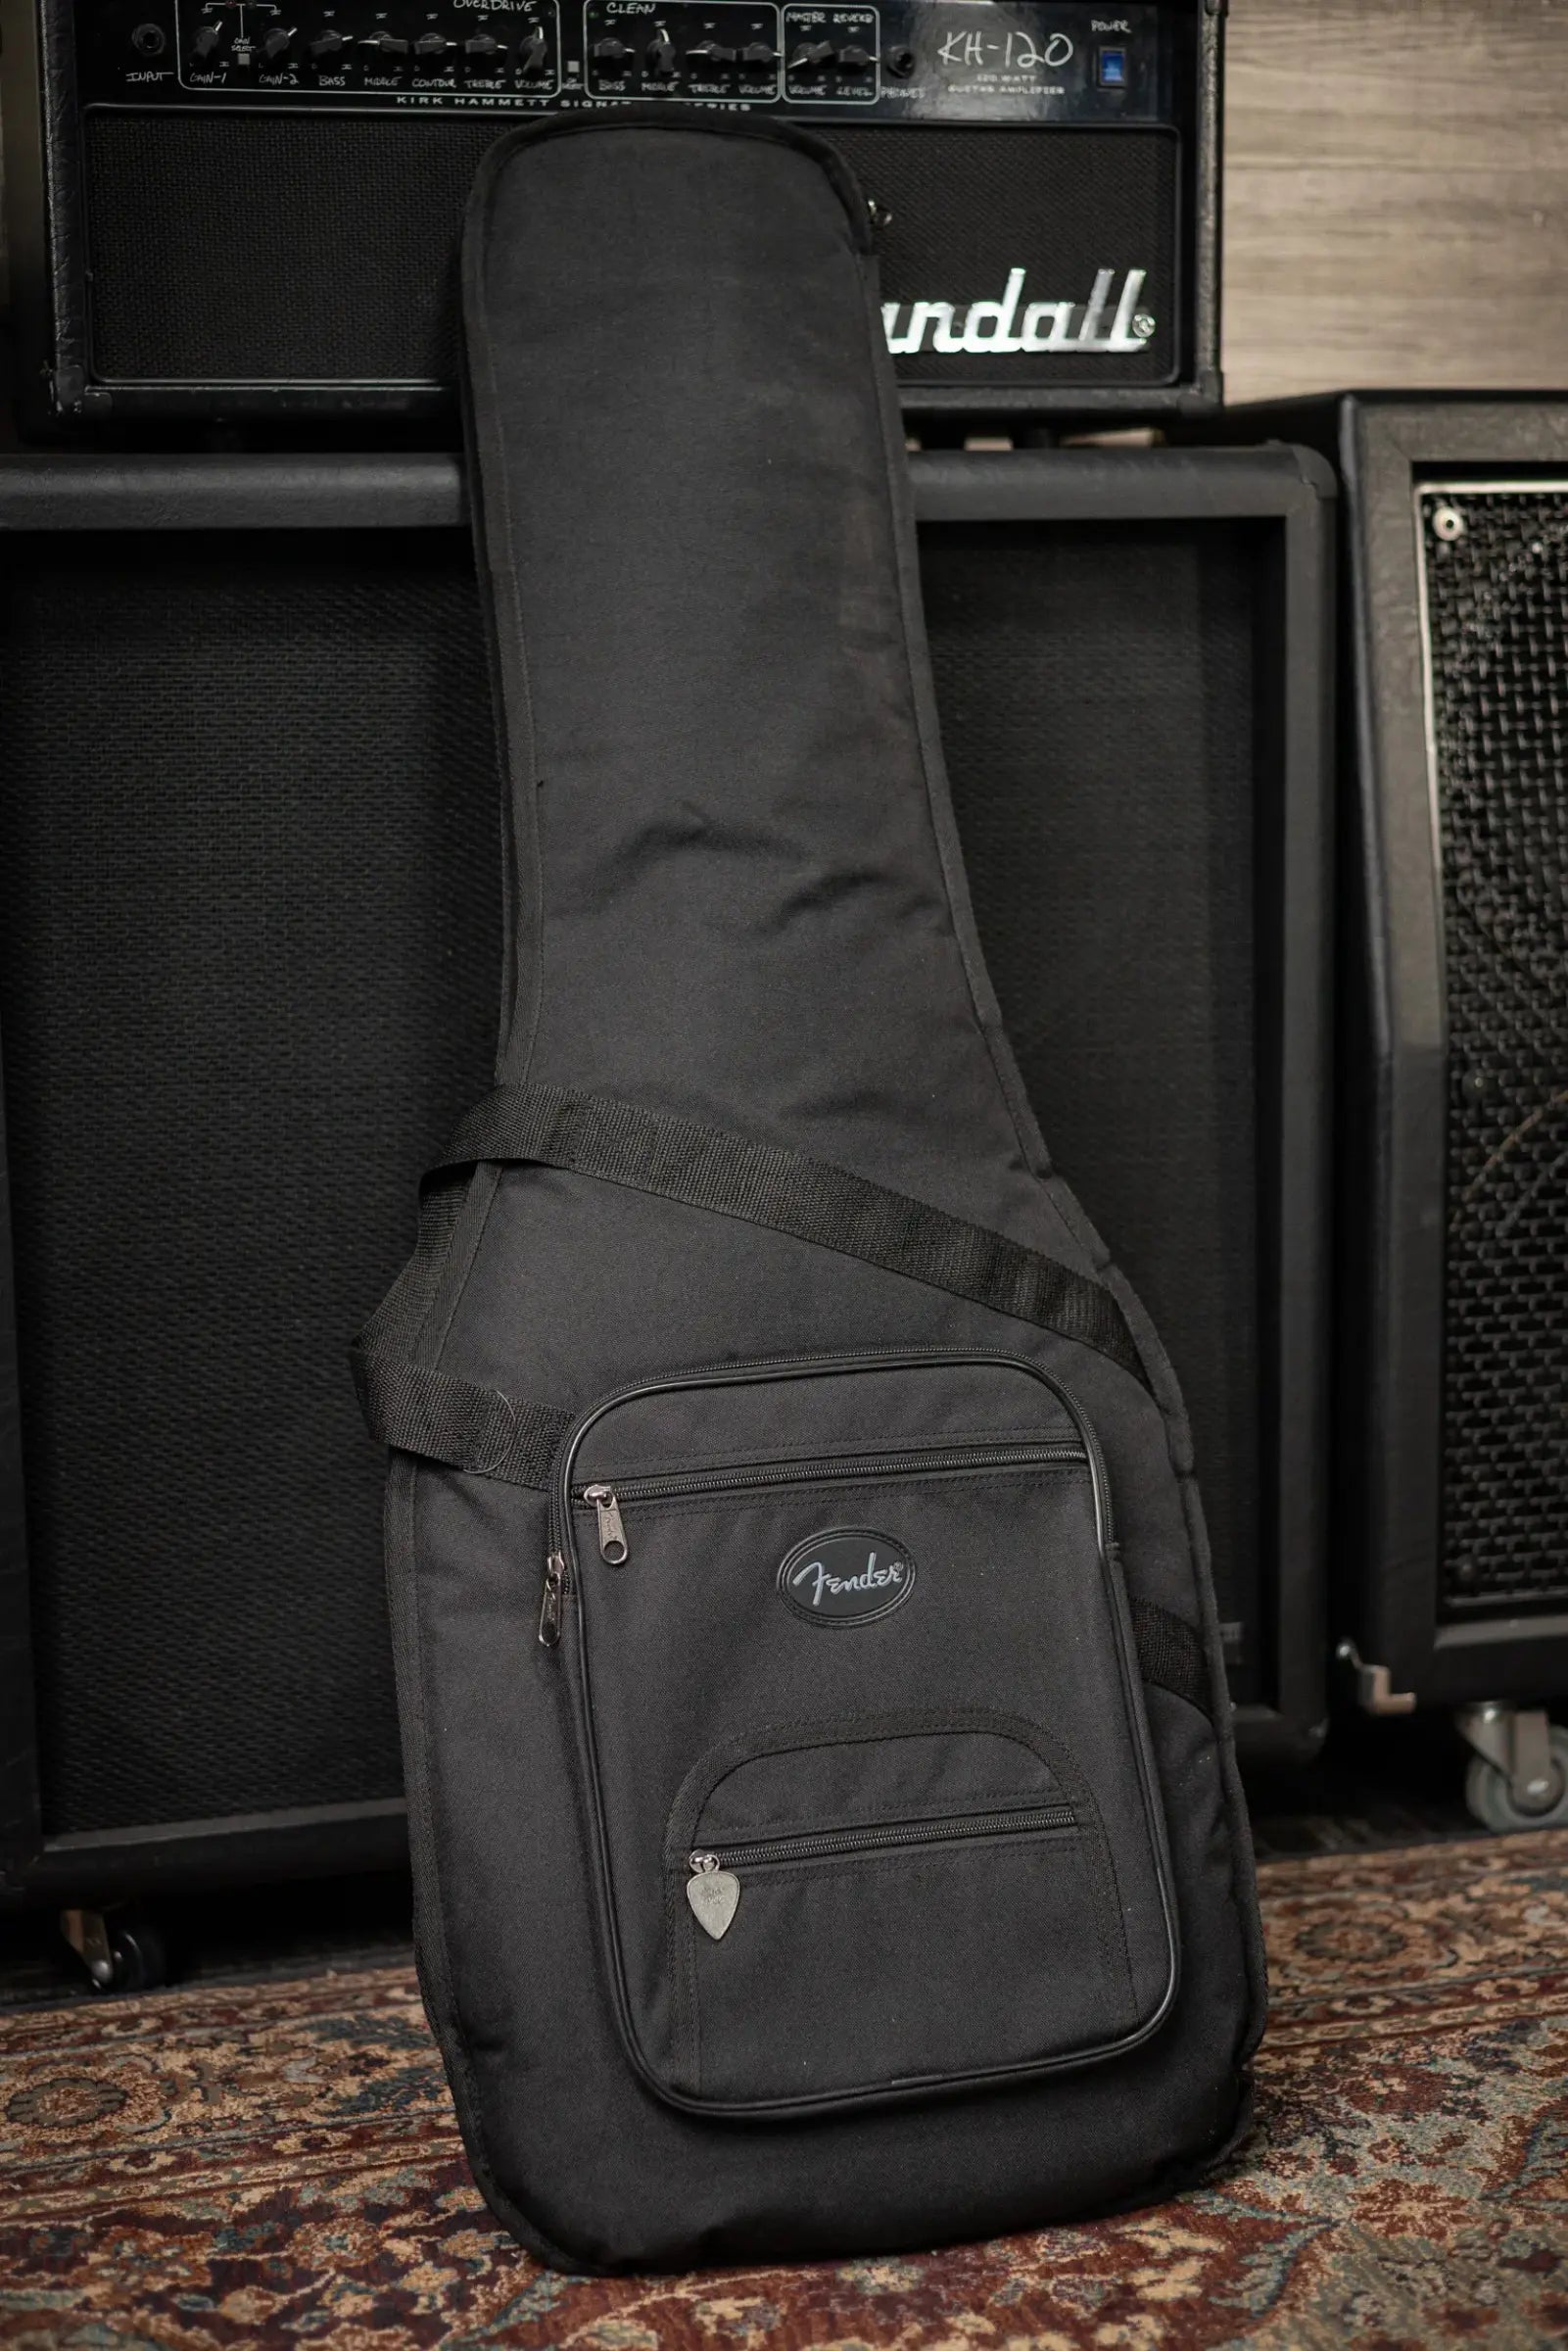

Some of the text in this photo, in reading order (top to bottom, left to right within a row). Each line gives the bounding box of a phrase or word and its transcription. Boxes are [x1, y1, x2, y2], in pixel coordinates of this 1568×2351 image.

[453, 0, 537, 12] OVERDRIVE
[606, 2, 656, 14] CLEAN
[1091, 20, 1131, 32] POWER
[937, 31, 1073, 68] KH-120
[125, 72, 174, 82] INPUT
[189, 72, 227, 84] GAIN-1
[259, 73, 300, 86] GAIN-2
[319, 74, 346, 86] BASS
[411, 78, 457, 89] CONTOUR
[514, 79, 554, 90] VOLUME
[397, 96, 444, 105] KIRK
[454, 97, 550, 107] HAMMETT
[880, 267, 1148, 353] ndall
[792, 1552, 902, 1607] Fender
